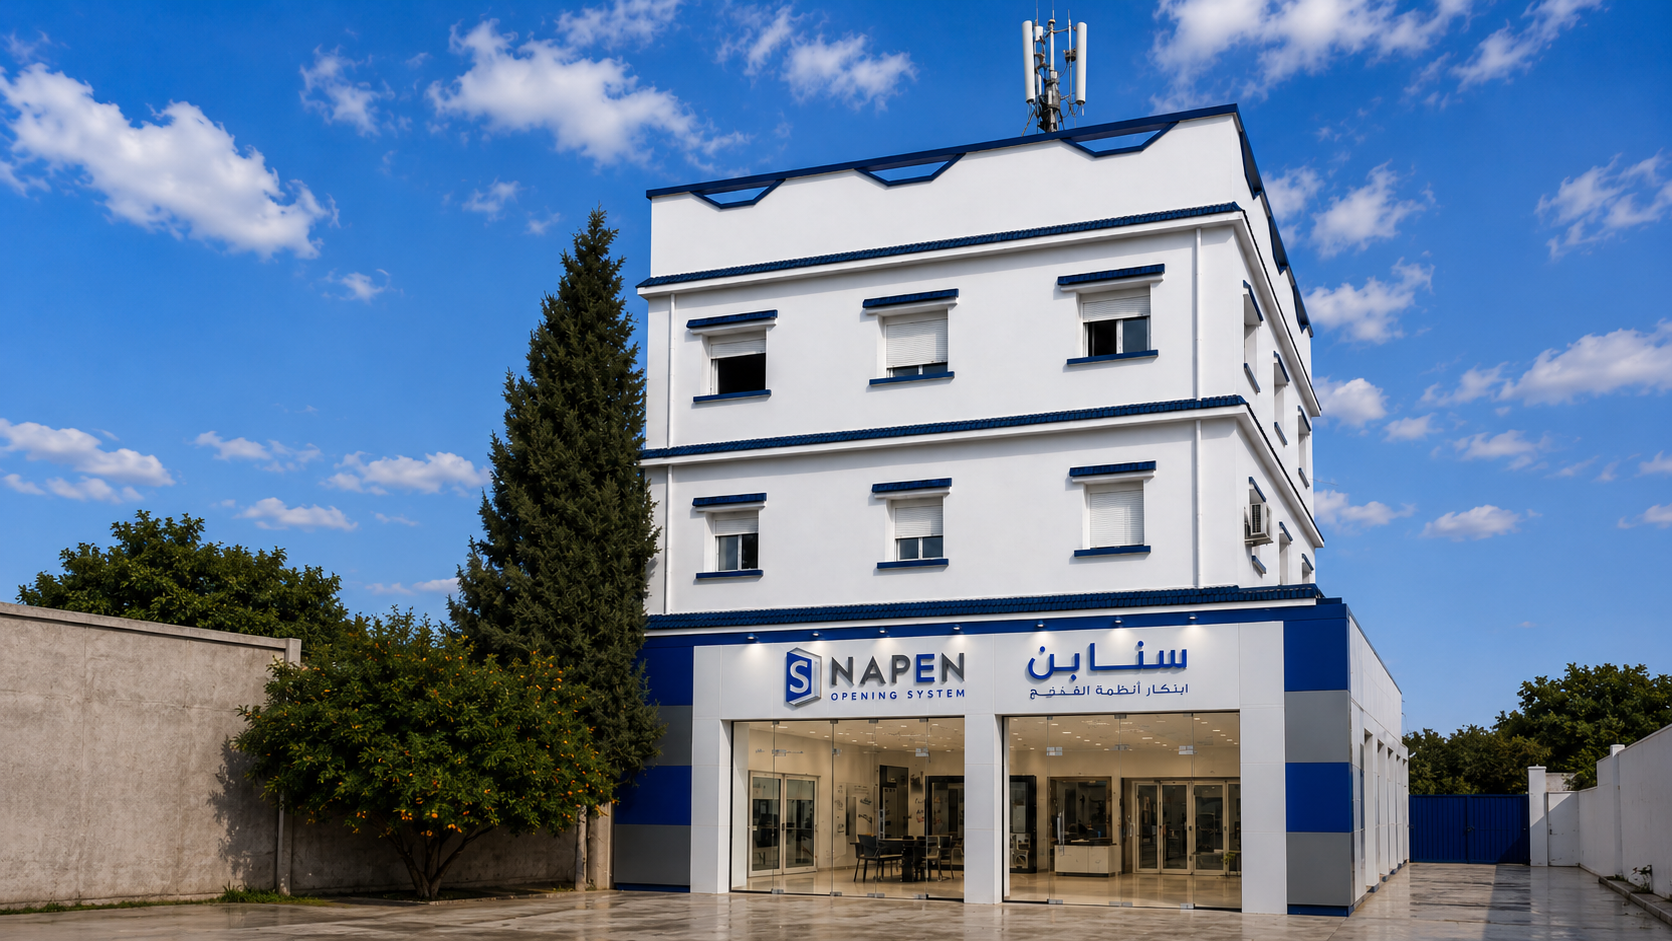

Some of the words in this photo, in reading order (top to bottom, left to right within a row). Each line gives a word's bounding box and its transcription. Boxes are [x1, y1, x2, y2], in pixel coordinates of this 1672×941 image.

[789, 660, 808, 694] S
[831, 653, 965, 686] NAPEN
[1027, 640, 1188, 681] سنابن
[831, 690, 897, 701] OPENING
[907, 689, 965, 699] SYSTEM
[1095, 681, 1141, 696] أنظمة
